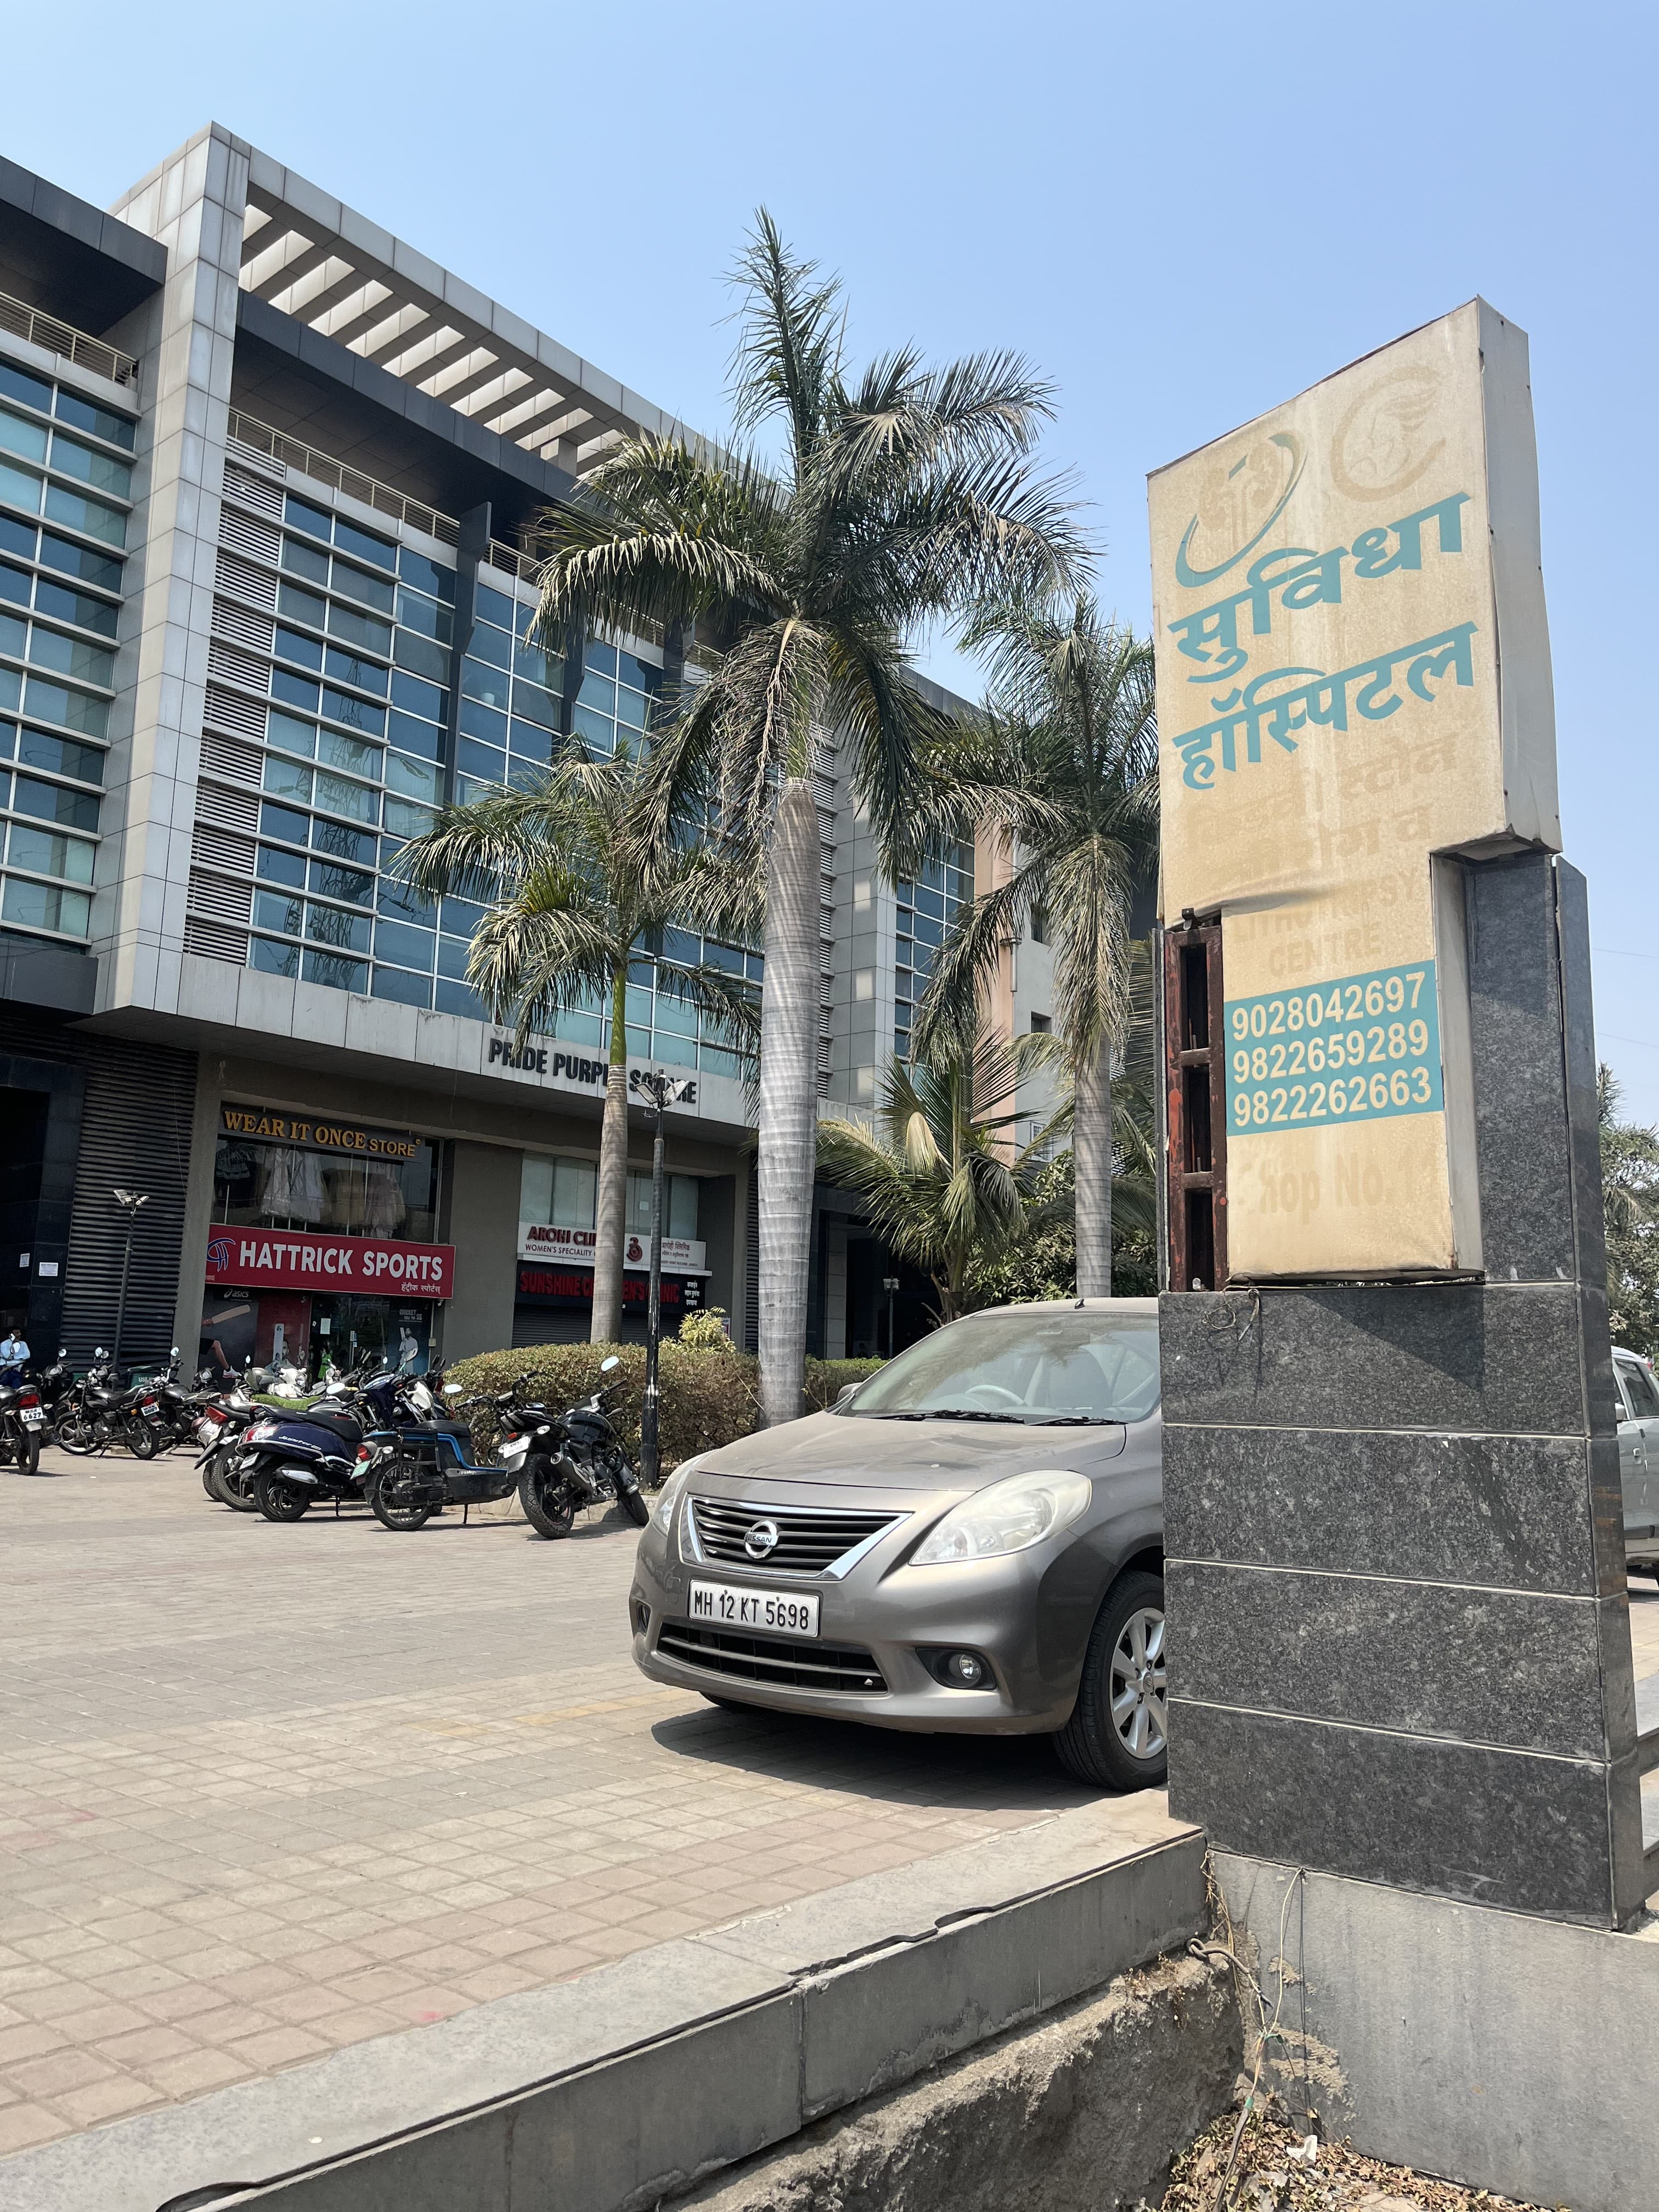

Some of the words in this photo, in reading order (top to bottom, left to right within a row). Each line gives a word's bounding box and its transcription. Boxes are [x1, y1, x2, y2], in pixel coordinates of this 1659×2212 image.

[1168, 491, 1471, 683] सुविधा
[1172, 620, 1476, 790] हॉस्पिटल
[1231, 970, 1426, 1042] 9028042697
[489, 1038, 548, 1074] PRIDE
[1232, 1018, 1429, 1085] 9822659289
[1233, 1065, 1432, 1128] 9822262663
[224, 1111, 285, 1137] WEAR
[290, 1122, 311, 1141] IT
[315, 1126, 366, 1149] ONCE
[369, 1138, 416, 1157] STORE
[525, 1244, 557, 1253] WOMEN'S
[558, 1247, 592, 1257] SPECIALITY
[527, 1226, 571, 1244] AROHI
[239, 1240, 354, 1275] HATTRICK
[362, 1251, 443, 1281] SPORTS
[520, 1271, 581, 1296] SUNSHINE
[24, 1412, 42, 1420] 6627
[747, 1535, 772, 1543] NISSAN
[695, 1590, 713, 1616] MH
[719, 1595, 735, 1619] 12
[741, 1597, 759, 1622] KT
[766, 1601, 809, 1630] 5698
